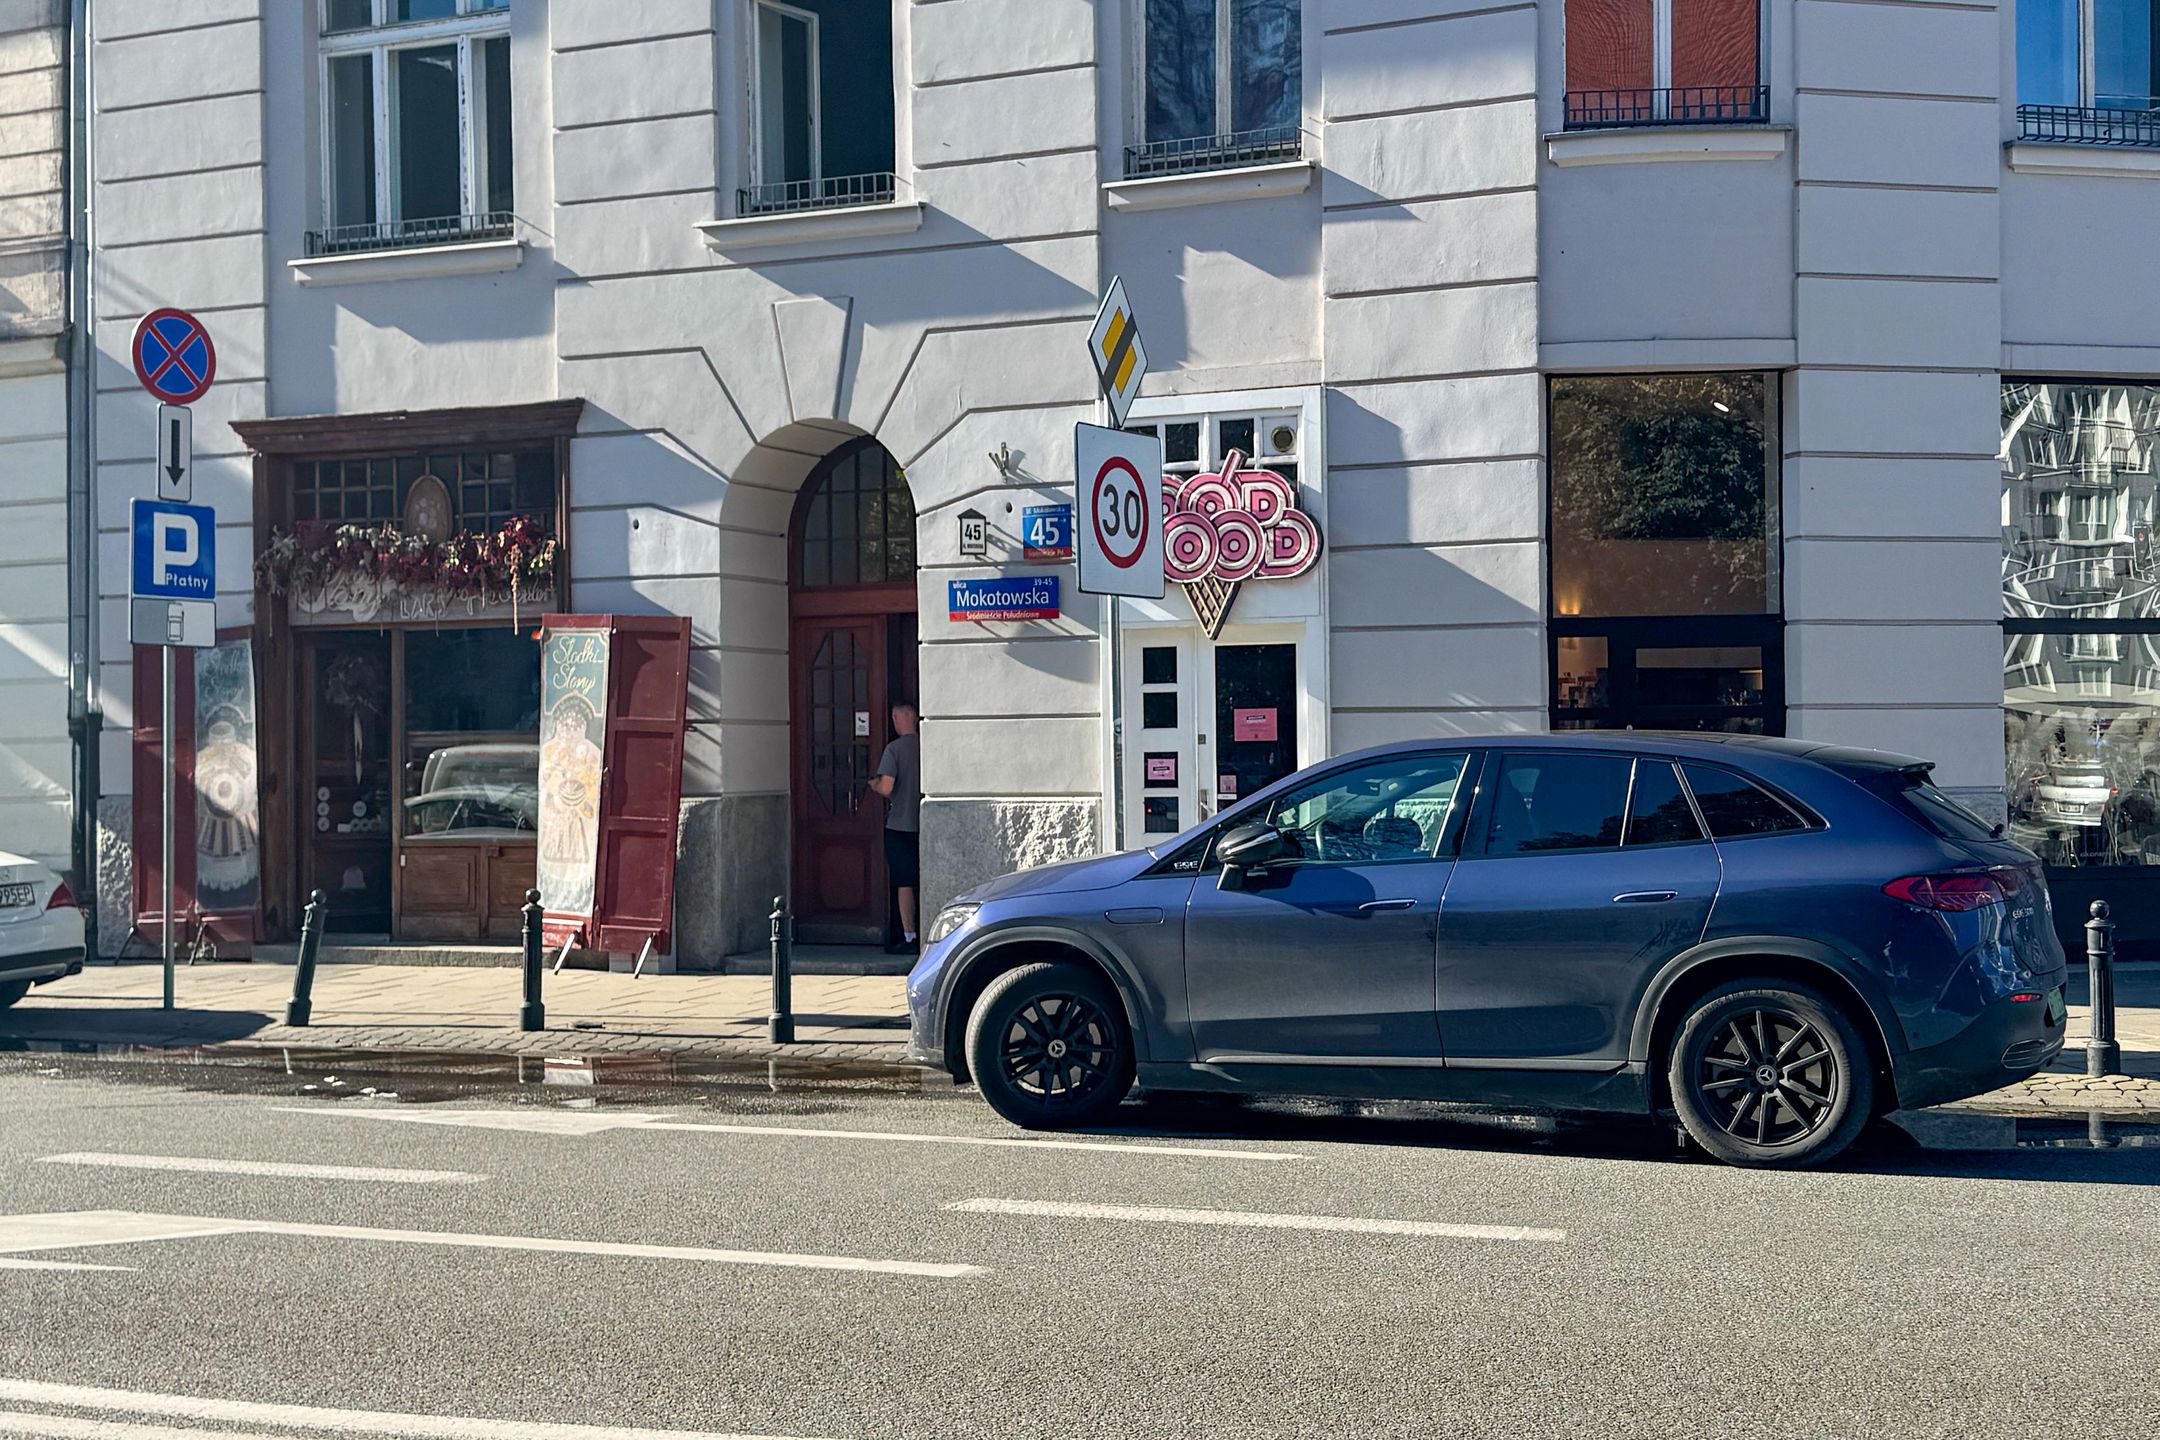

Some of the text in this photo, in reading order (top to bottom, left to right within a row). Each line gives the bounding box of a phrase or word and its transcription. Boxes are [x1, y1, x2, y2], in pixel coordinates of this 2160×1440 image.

[1102, 483, 1142, 539] 30
[964, 523, 981, 541] 45
[1030, 517, 1060, 546] 45
[153, 511, 199, 586] P
[165, 572, 209, 592] Płatny
[1034, 578, 1053, 586] 39-45
[956, 586, 1049, 607] Mokotowska
